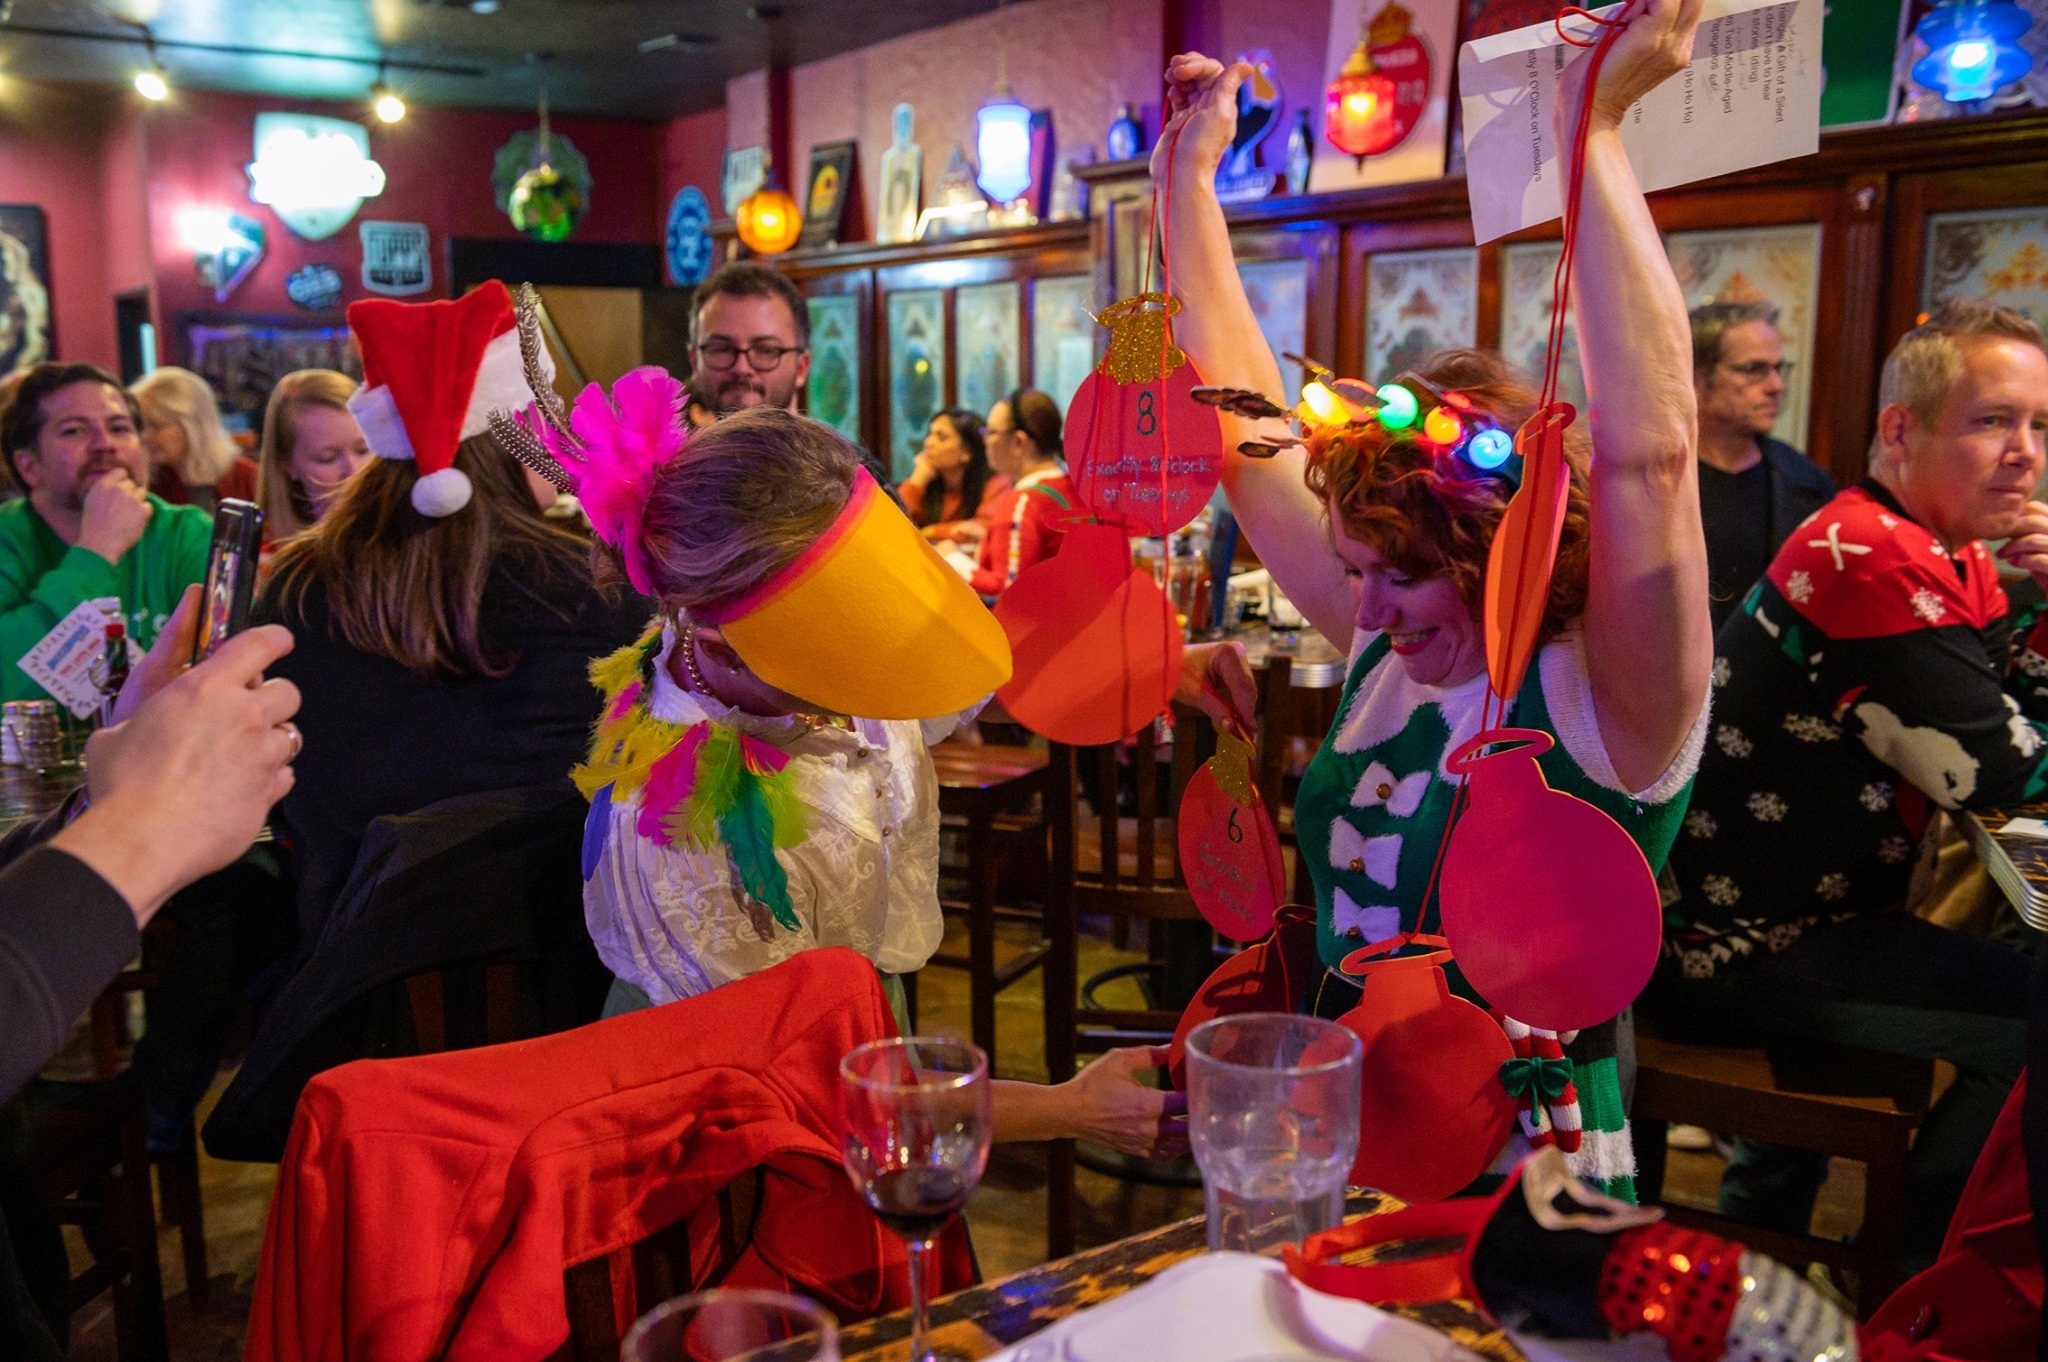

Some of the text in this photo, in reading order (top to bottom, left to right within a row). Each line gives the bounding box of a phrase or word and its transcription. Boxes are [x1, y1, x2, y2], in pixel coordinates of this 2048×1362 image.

[1750, 18, 1760, 50] stories
[1764, 13, 1774, 41] don't
[1724, 28, 1735, 50] Two
[1777, 45, 1787, 53] A
[1764, 41, 1774, 66] have
[1777, 55, 1787, 74] Gift
[1528, 71, 1538, 79] 8
[1683, 71, 1694, 88] (Ho
[1748, 55, 1760, 83] (ding)
[1763, 67, 1772, 78] to
[1722, 51, 1734, 114] Middle-Aged
[1762, 79, 1772, 101] hear
[1776, 75, 1786, 86] of
[1529, 80, 1540, 119] O'Clock
[1684, 90, 1694, 105] Ho
[1633, 108, 1643, 125] the
[1683, 106, 1694, 124] Ho)
[1775, 96, 1786, 123] Silent
[1530, 121, 1539, 134] on
[1532, 136, 1543, 182] Tuesdays
[1136, 391, 1157, 436] 8
[1103, 488, 1122, 504] on
[1228, 807, 1244, 843] 6
